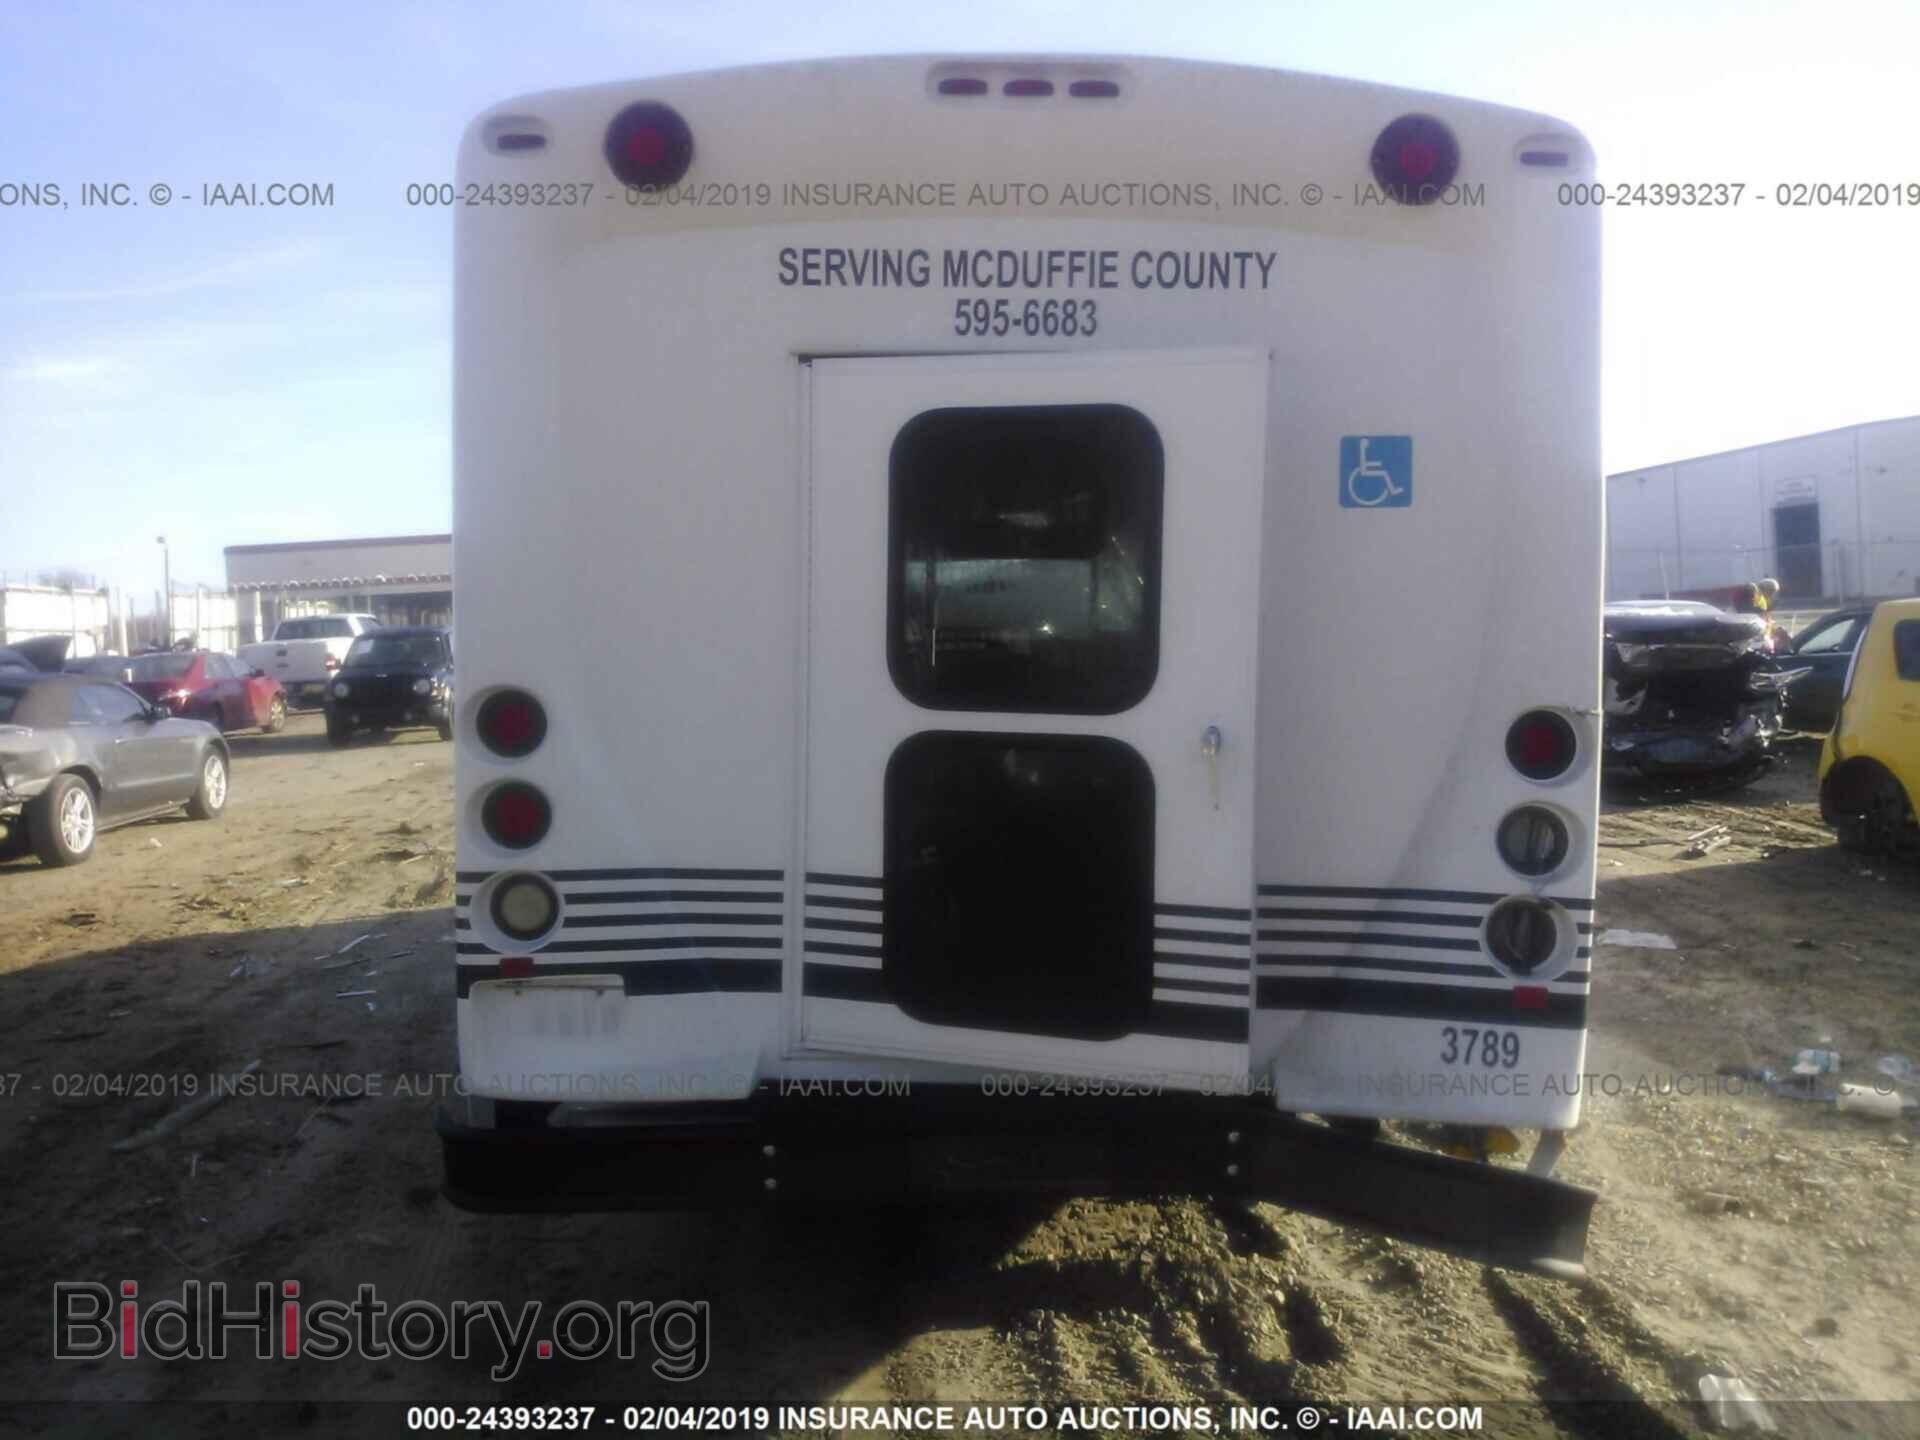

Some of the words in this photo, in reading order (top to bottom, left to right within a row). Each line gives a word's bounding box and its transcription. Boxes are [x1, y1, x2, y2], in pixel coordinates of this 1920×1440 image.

[778, 247, 931, 288] SERVING
[943, 250, 1119, 289] MCDUFFIE
[1130, 252, 1277, 289] COUNTY
[954, 299, 1097, 337] 595-6683
[1441, 1027, 1520, 1068] 3789
